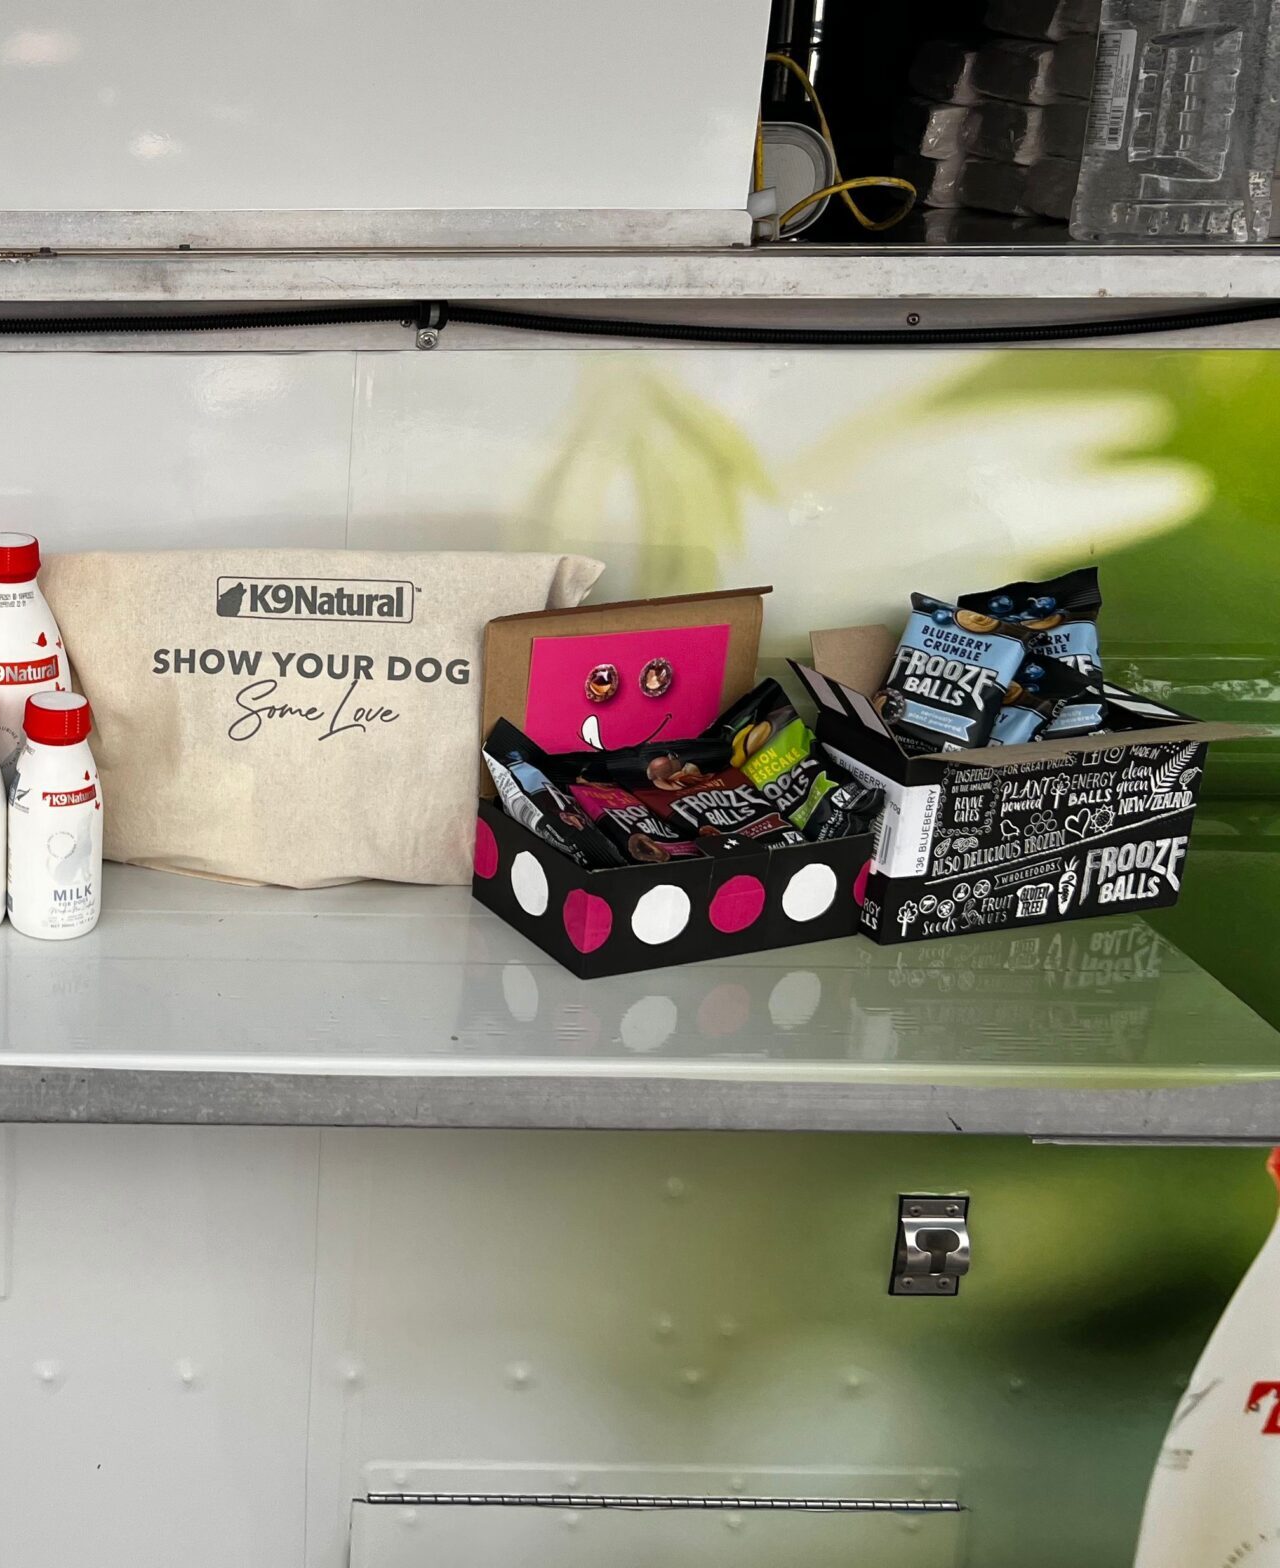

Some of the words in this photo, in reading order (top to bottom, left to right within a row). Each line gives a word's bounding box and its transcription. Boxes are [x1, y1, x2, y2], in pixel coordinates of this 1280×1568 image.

[249, 584, 404, 618] K9Natural
[921, 625, 993, 652] BLUEBERRY
[923, 638, 982, 662] CRUMBLE
[152, 648, 263, 676] SHOW
[272, 652, 375, 681] YOUR
[386, 656, 471, 685] DOG
[886, 646, 999, 712] FROOZE
[903, 676, 966, 706] BALLS
[228, 679, 325, 742] Some
[318, 679, 400, 742] Love
[749, 747, 778, 774] EMON
[1130, 744, 1150, 758] MADE
[1150, 748, 1160, 760] IN
[752, 748, 802, 784] ESECAKE
[839, 758, 887, 791] BLUEBERRY
[955, 767, 994, 784] INSPIRED
[1003, 765, 1018, 776] FOR
[1020, 760, 1050, 774] GREAT
[1122, 760, 1152, 780] clean
[1000, 776, 1056, 802] PLANT
[1071, 771, 1118, 790] ENERGY
[1116, 780, 1148, 800] green
[52, 787, 96, 806] K9Natural
[776, 774, 810, 812] ALLS
[955, 795, 984, 811] REVIVE
[1068, 788, 1113, 806] BALLS
[1118, 794, 1148, 816] NEW
[1150, 790, 1193, 810] ZEALAND
[671, 784, 771, 828] FROOZE
[705, 806, 756, 827] BALLS
[1001, 794, 1043, 818] powered
[636, 818, 679, 839] BALLS
[918, 788, 939, 854] BLUEBERRY
[932, 855, 961, 876] ALSO
[963, 840, 1021, 870] DELICIOUS
[1024, 828, 1066, 854] FROZEN
[916, 858, 925, 874] 136
[1001, 862, 1056, 884] WHOLEFOODS
[1078, 836, 1189, 907] FROOZE
[54, 882, 92, 902] MILK
[1020, 885, 1050, 902] GLUTEN
[1098, 872, 1162, 905] BALLS
[863, 899, 880, 916] RGY
[980, 894, 1014, 913] FRUIT
[860, 912, 878, 930] LLS
[978, 910, 1008, 926] NUTS
